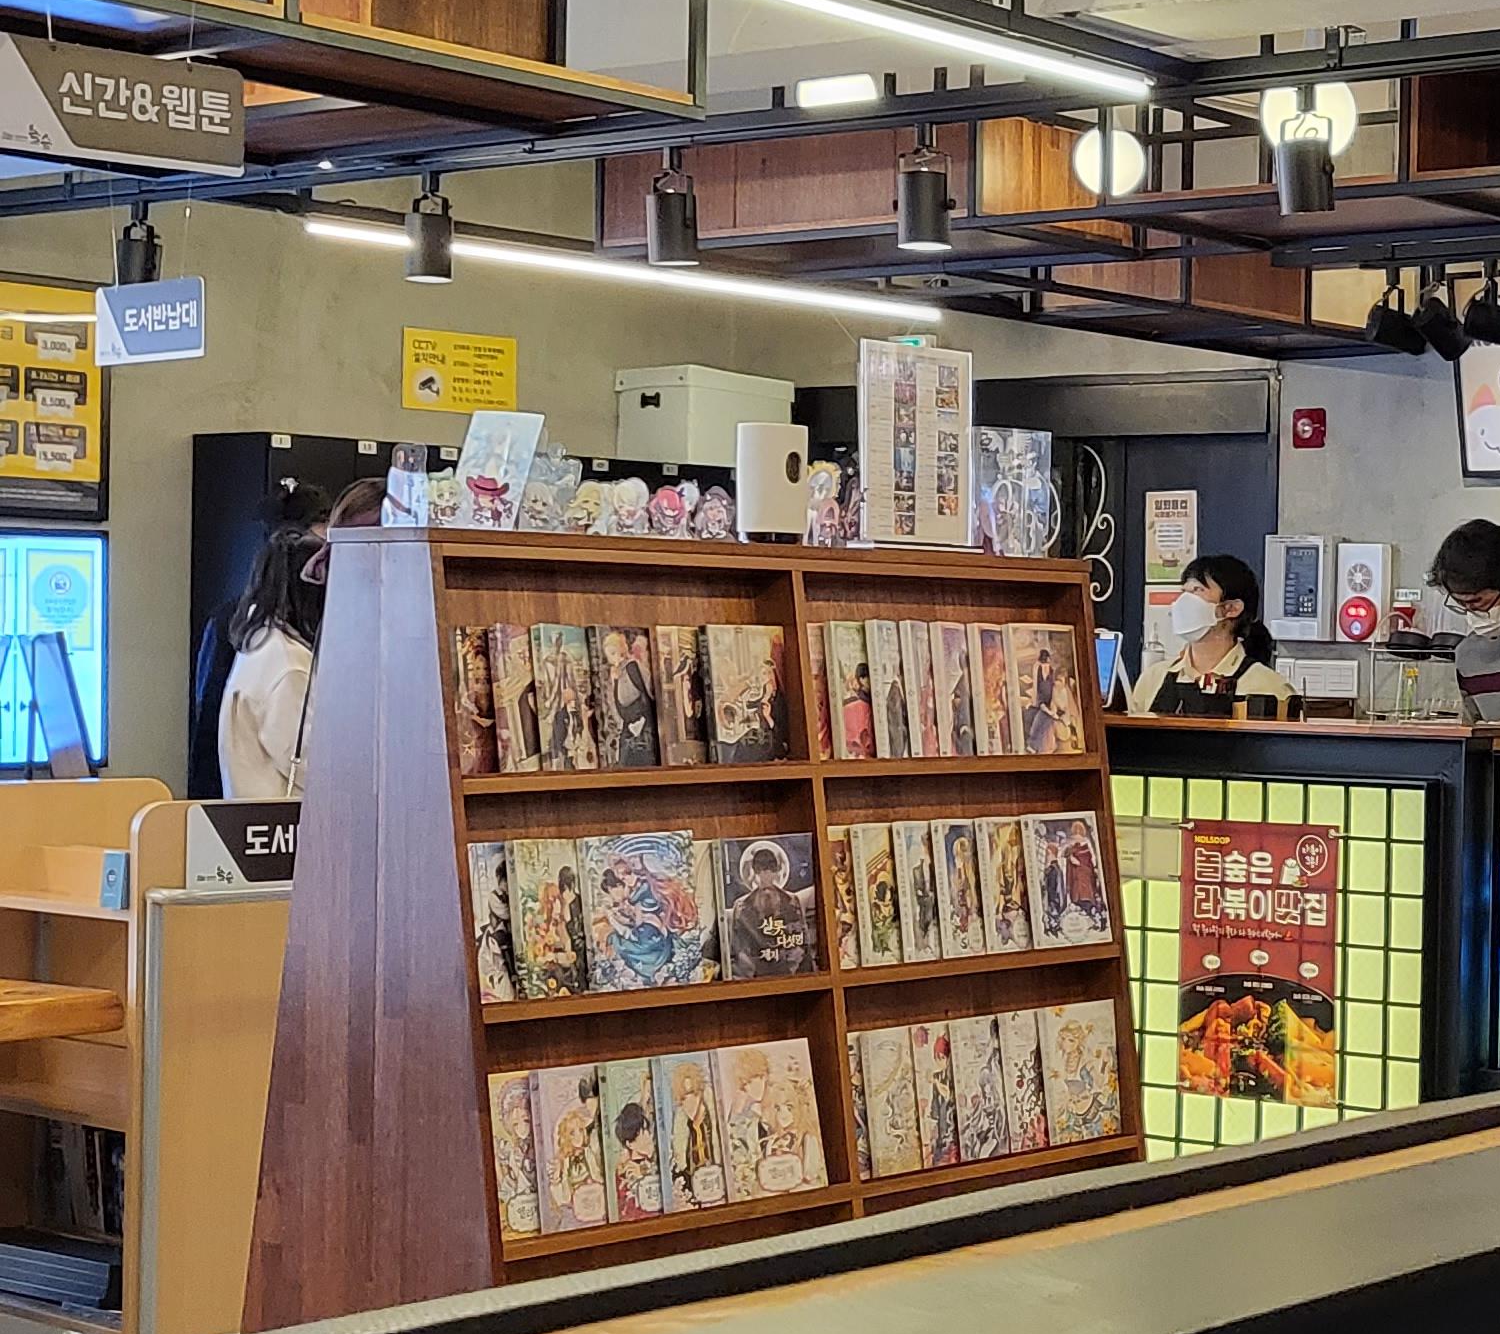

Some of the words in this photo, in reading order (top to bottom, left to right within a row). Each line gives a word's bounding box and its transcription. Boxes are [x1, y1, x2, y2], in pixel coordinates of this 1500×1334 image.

[58, 71, 232, 135] 신간&웹툰
[123, 300, 198, 333] 도서반납대
[1194, 834, 1231, 845] NOLSOOP
[1194, 847, 1274, 885] 놀숲은
